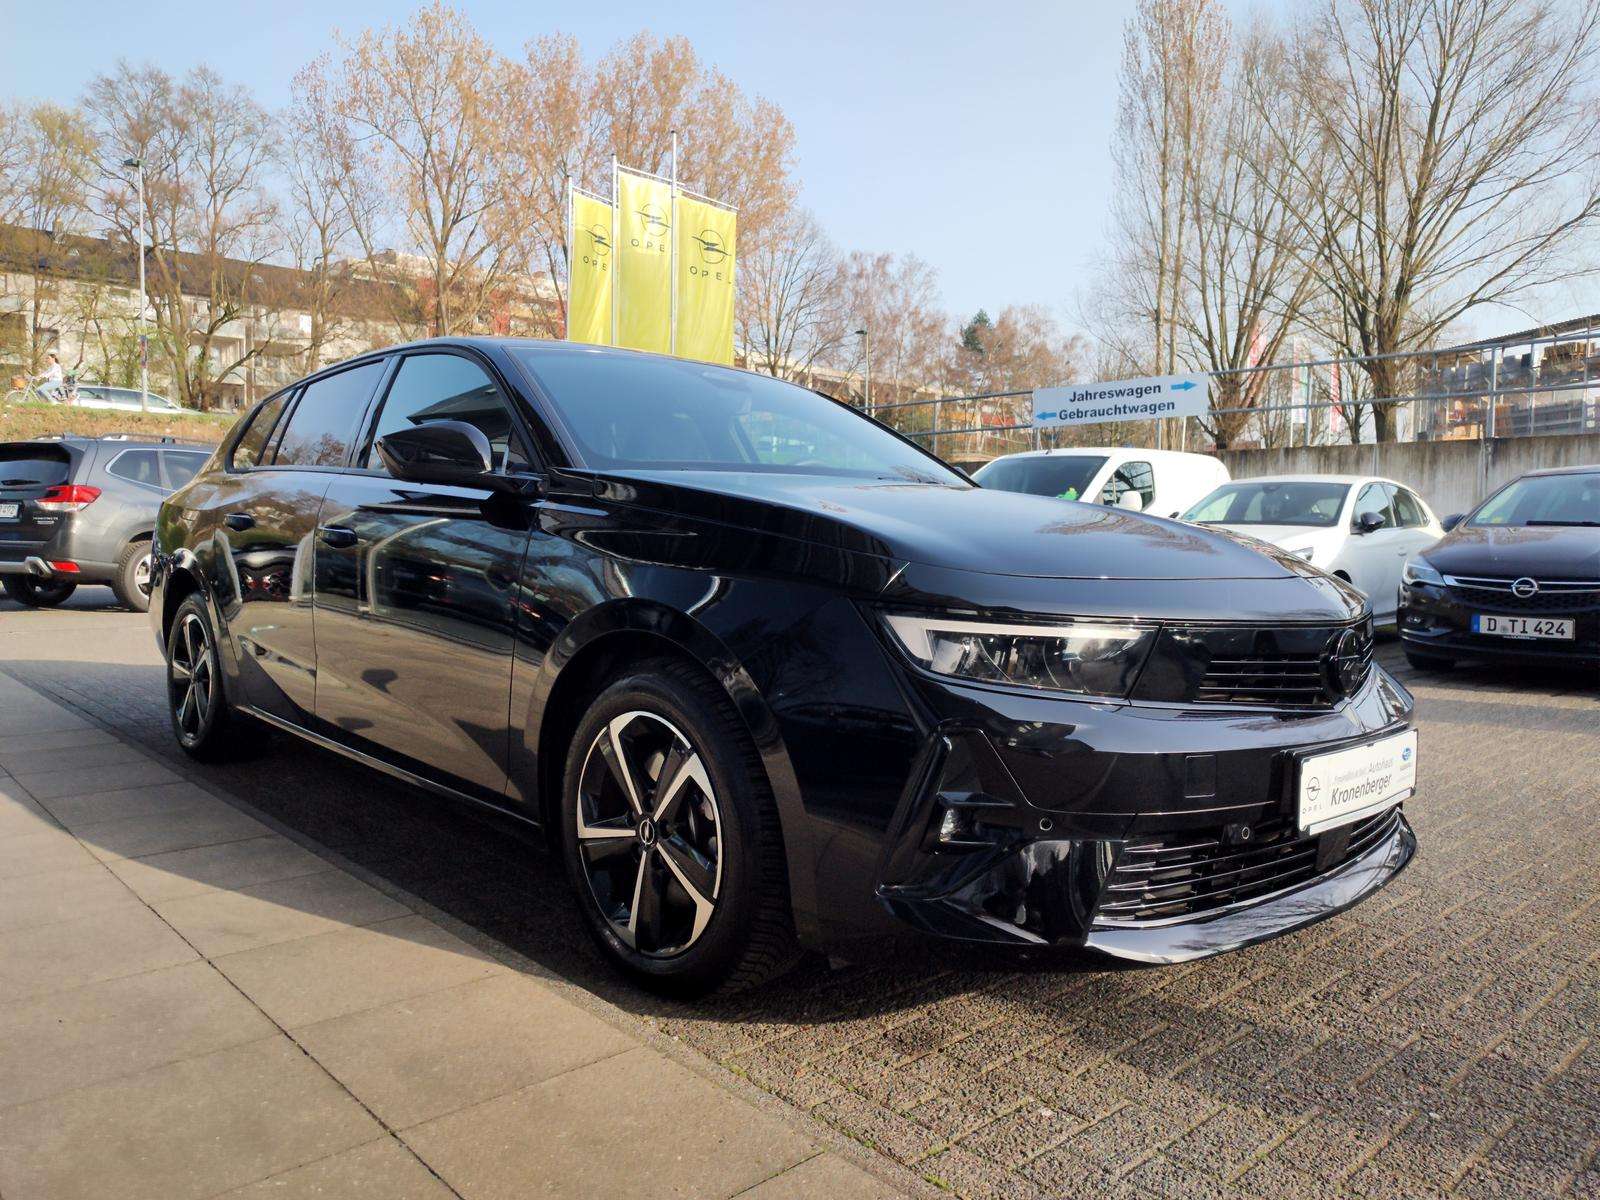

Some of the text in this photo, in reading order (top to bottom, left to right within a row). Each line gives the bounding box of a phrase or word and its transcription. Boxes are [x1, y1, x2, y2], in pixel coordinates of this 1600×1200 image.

[630, 238, 665, 253] OPE
[583, 255, 608, 272] OPE
[689, 265, 732, 285] OPE
[1069, 383, 1162, 403] Jahreswagen
[1058, 401, 1176, 421] Gebrauchtwagen
[1487, 617, 1497, 632] D
[1509, 619, 1528, 634] TI
[1533, 621, 1566, 636] 424
[1330, 774, 1392, 806] Kronenberger
